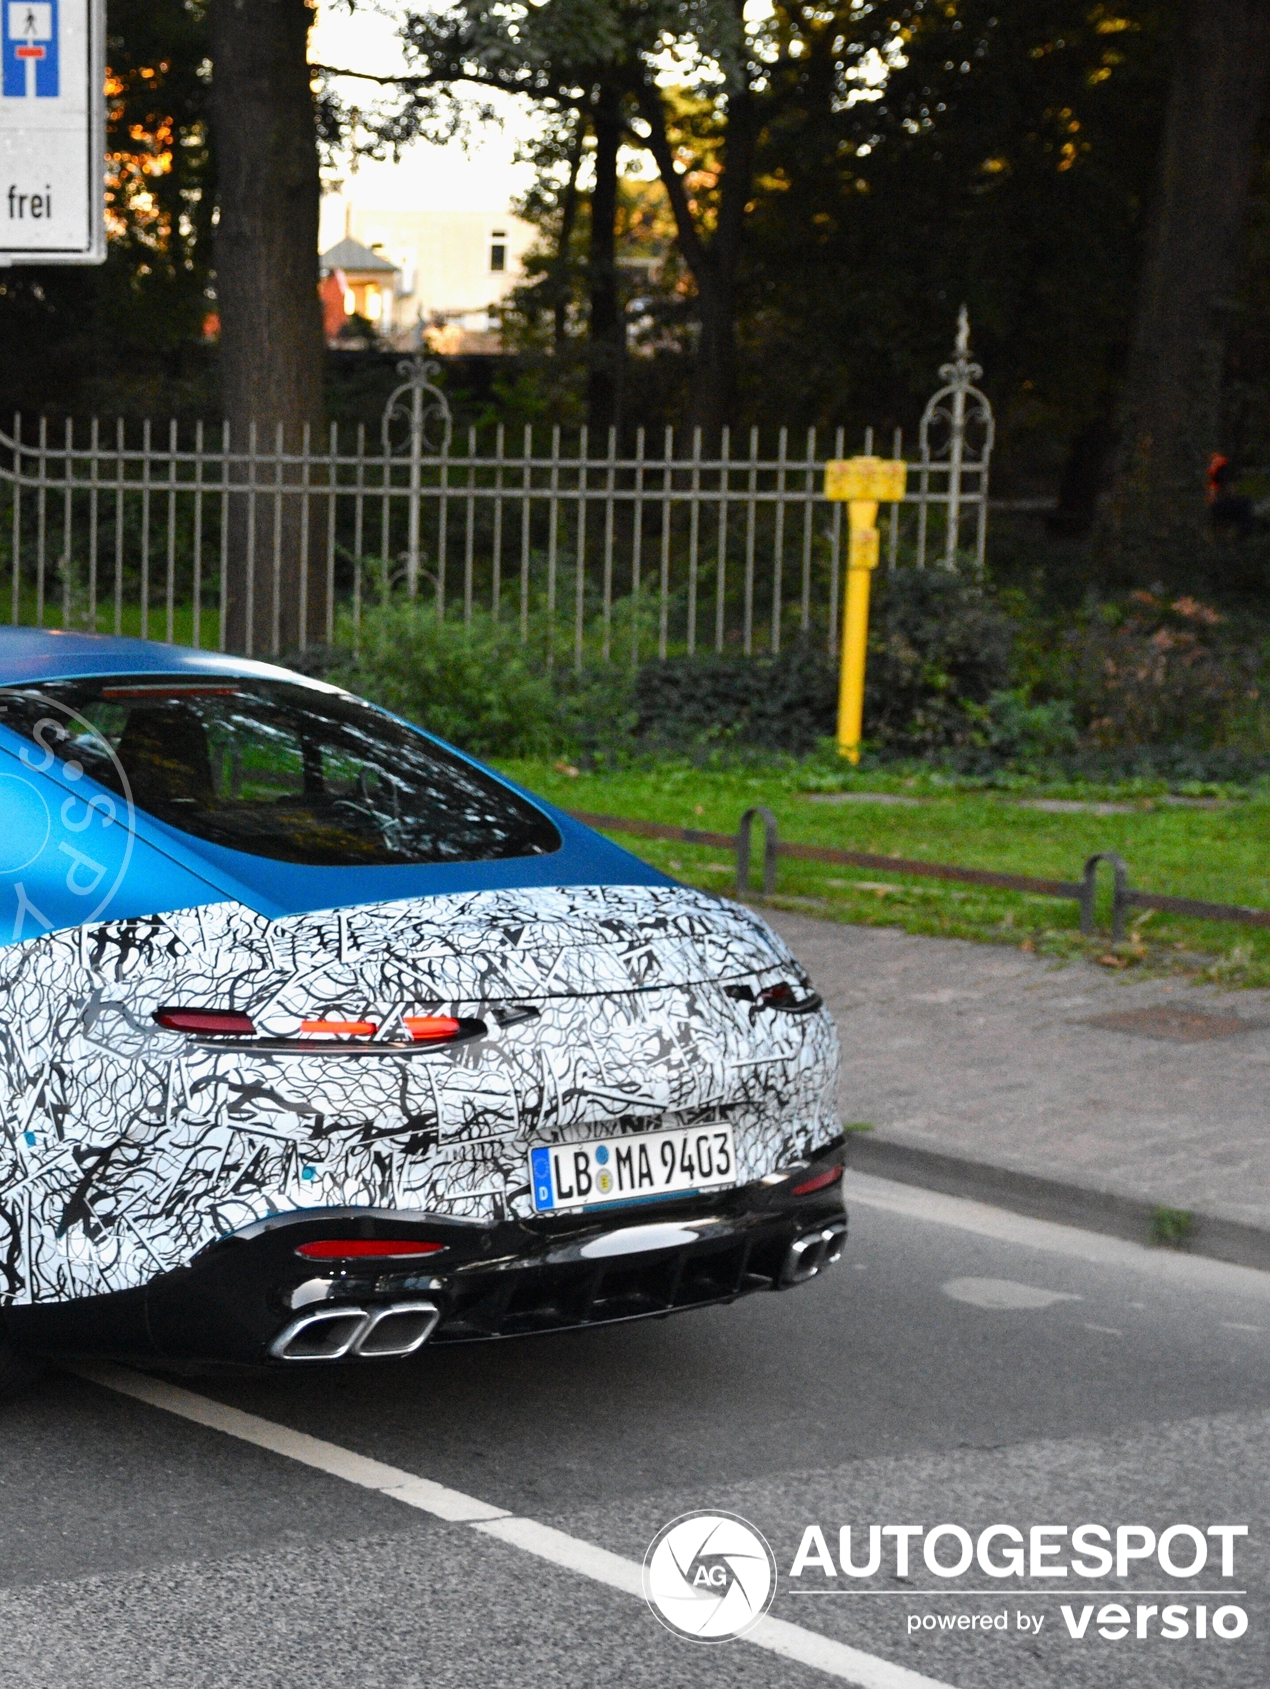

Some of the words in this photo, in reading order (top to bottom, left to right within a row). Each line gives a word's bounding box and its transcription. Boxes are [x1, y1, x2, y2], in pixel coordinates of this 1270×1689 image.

[8, 184, 52, 219] frei
[554, 1151, 592, 1200] LB
[615, 1143, 654, 1191] MA
[660, 1132, 730, 1184] 9403
[538, 1186, 548, 1200] D
